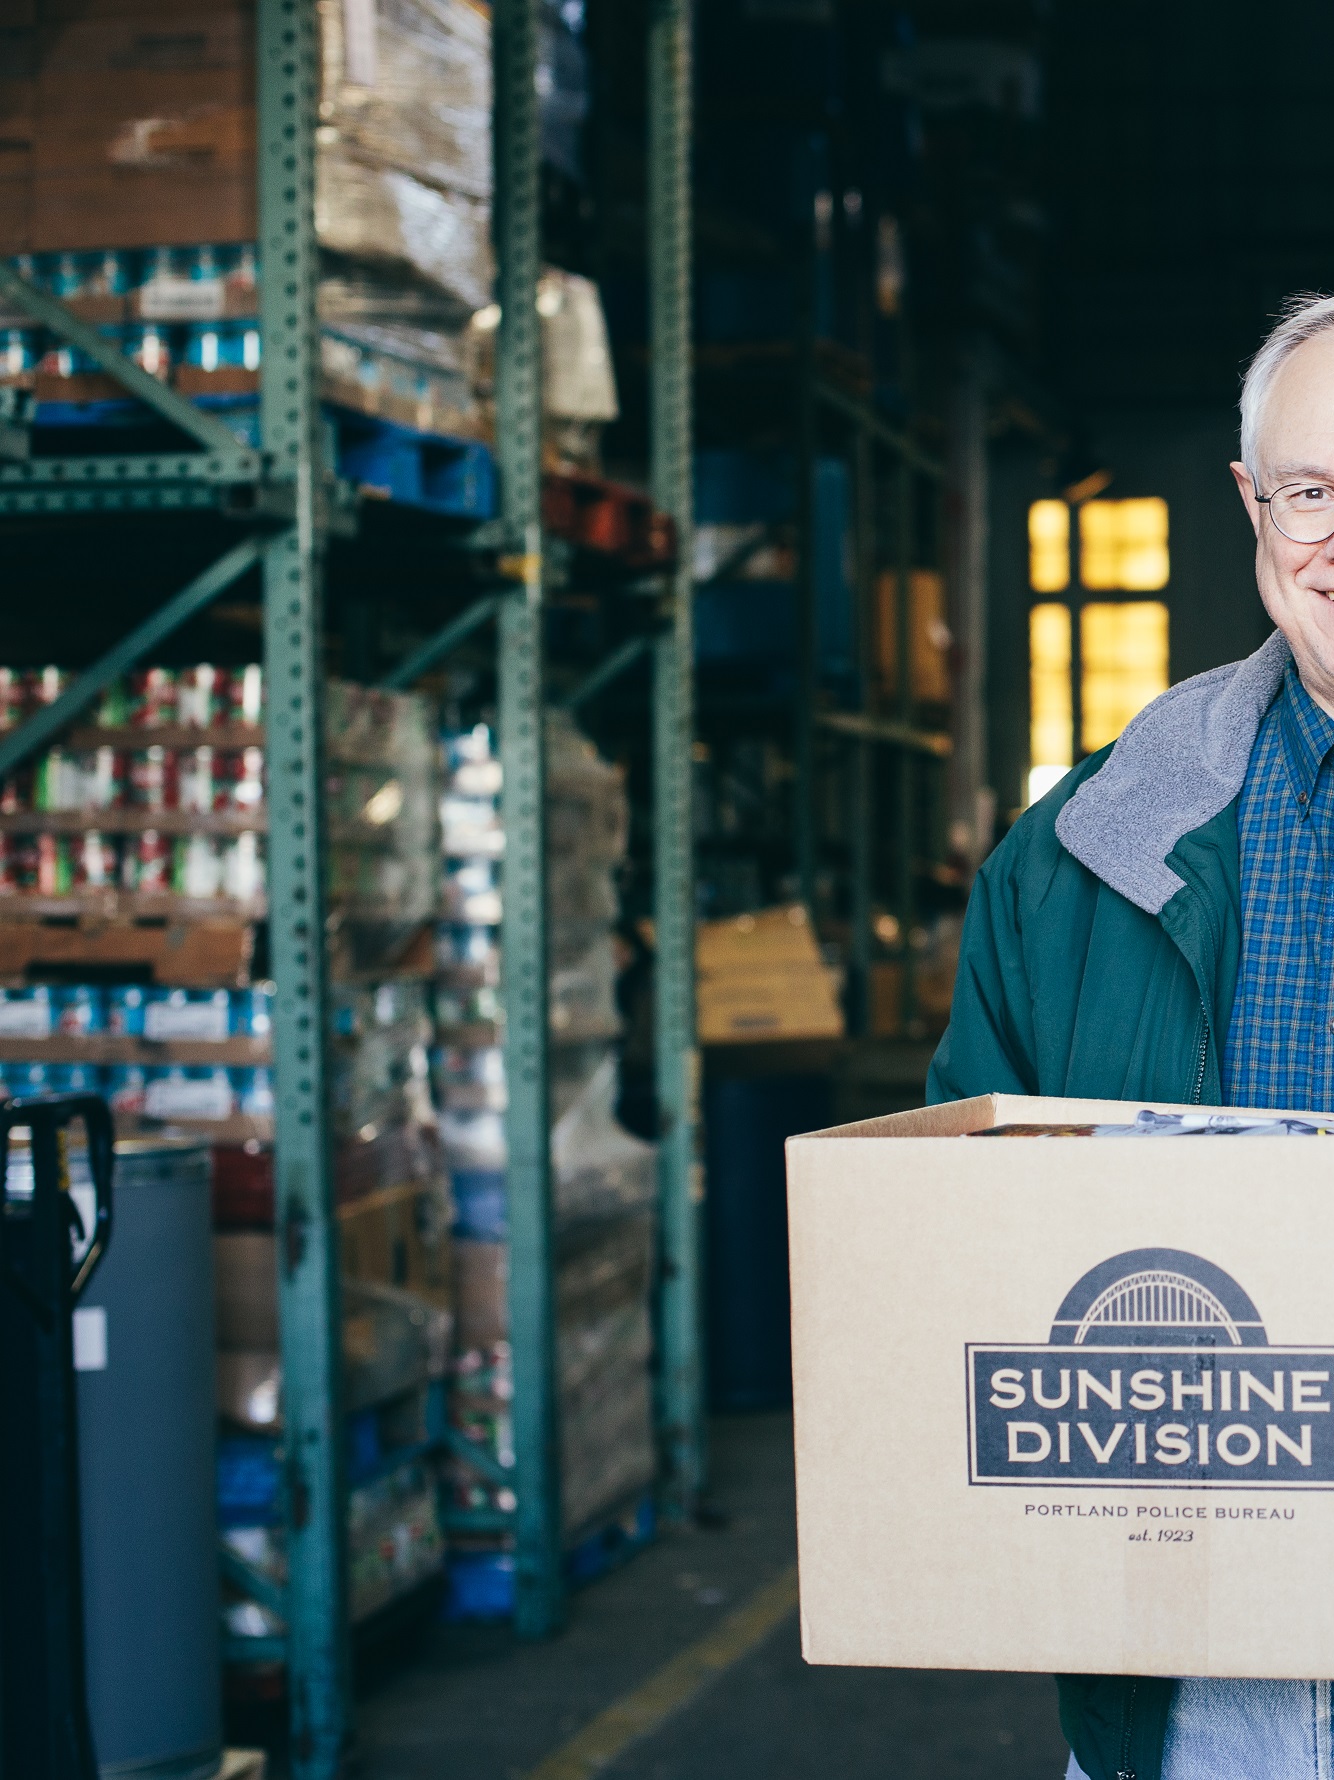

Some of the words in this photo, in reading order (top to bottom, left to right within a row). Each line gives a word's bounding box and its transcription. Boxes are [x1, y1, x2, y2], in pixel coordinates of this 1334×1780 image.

[989, 1368, 1331, 1413] SUNSHINE
[1006, 1421, 1313, 1466] DIVISION
[1024, 1504, 1129, 1518] PORTLAND
[1136, 1506, 1208, 1519] POLICE
[1215, 1508, 1296, 1520] BUREAU
[1127, 1529, 1152, 1542] est.
[1157, 1529, 1195, 1543] 1923
